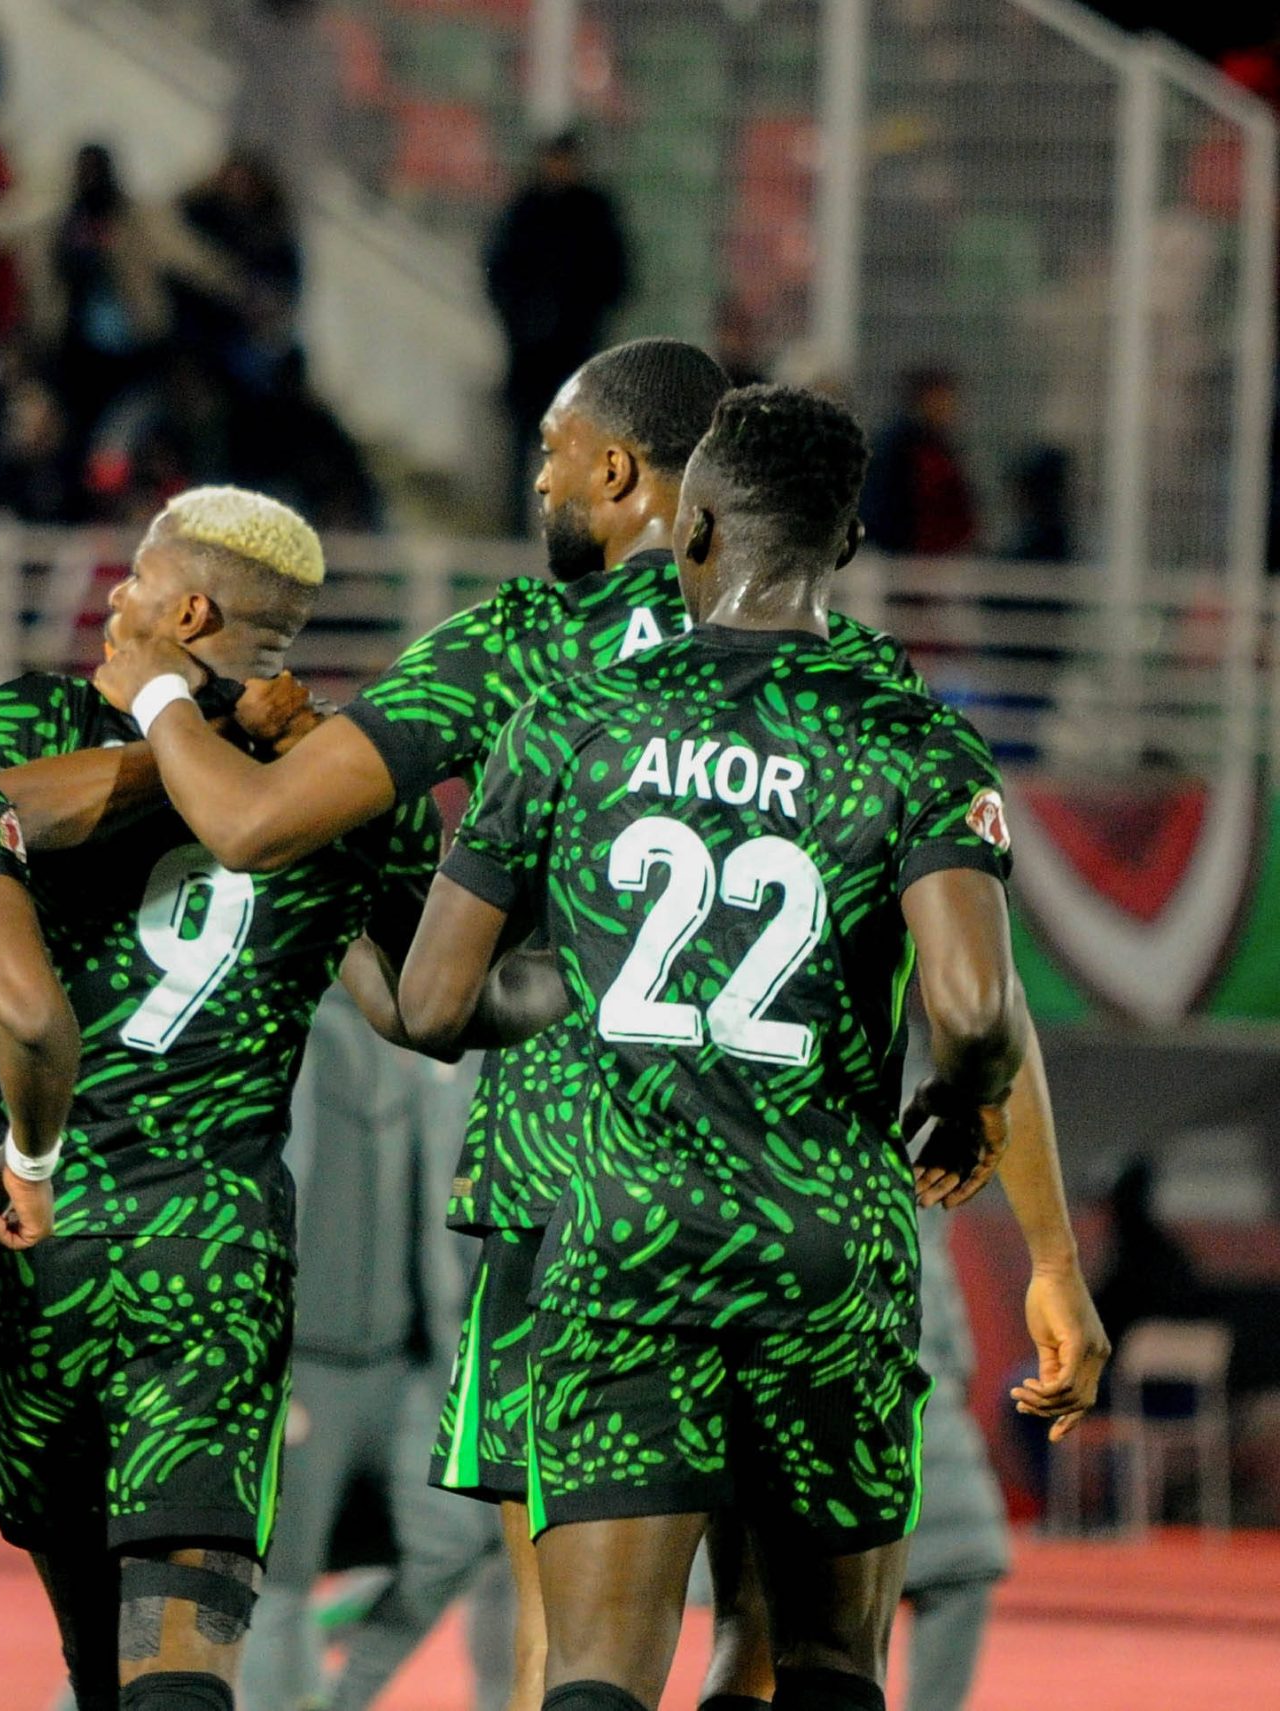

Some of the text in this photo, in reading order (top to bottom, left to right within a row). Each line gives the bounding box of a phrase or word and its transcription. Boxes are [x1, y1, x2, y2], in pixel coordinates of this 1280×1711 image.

[618, 606, 693, 660] A
[627, 737, 805, 818] AKOR
[118, 842, 255, 1055] 9
[598, 815, 827, 1066] 22
